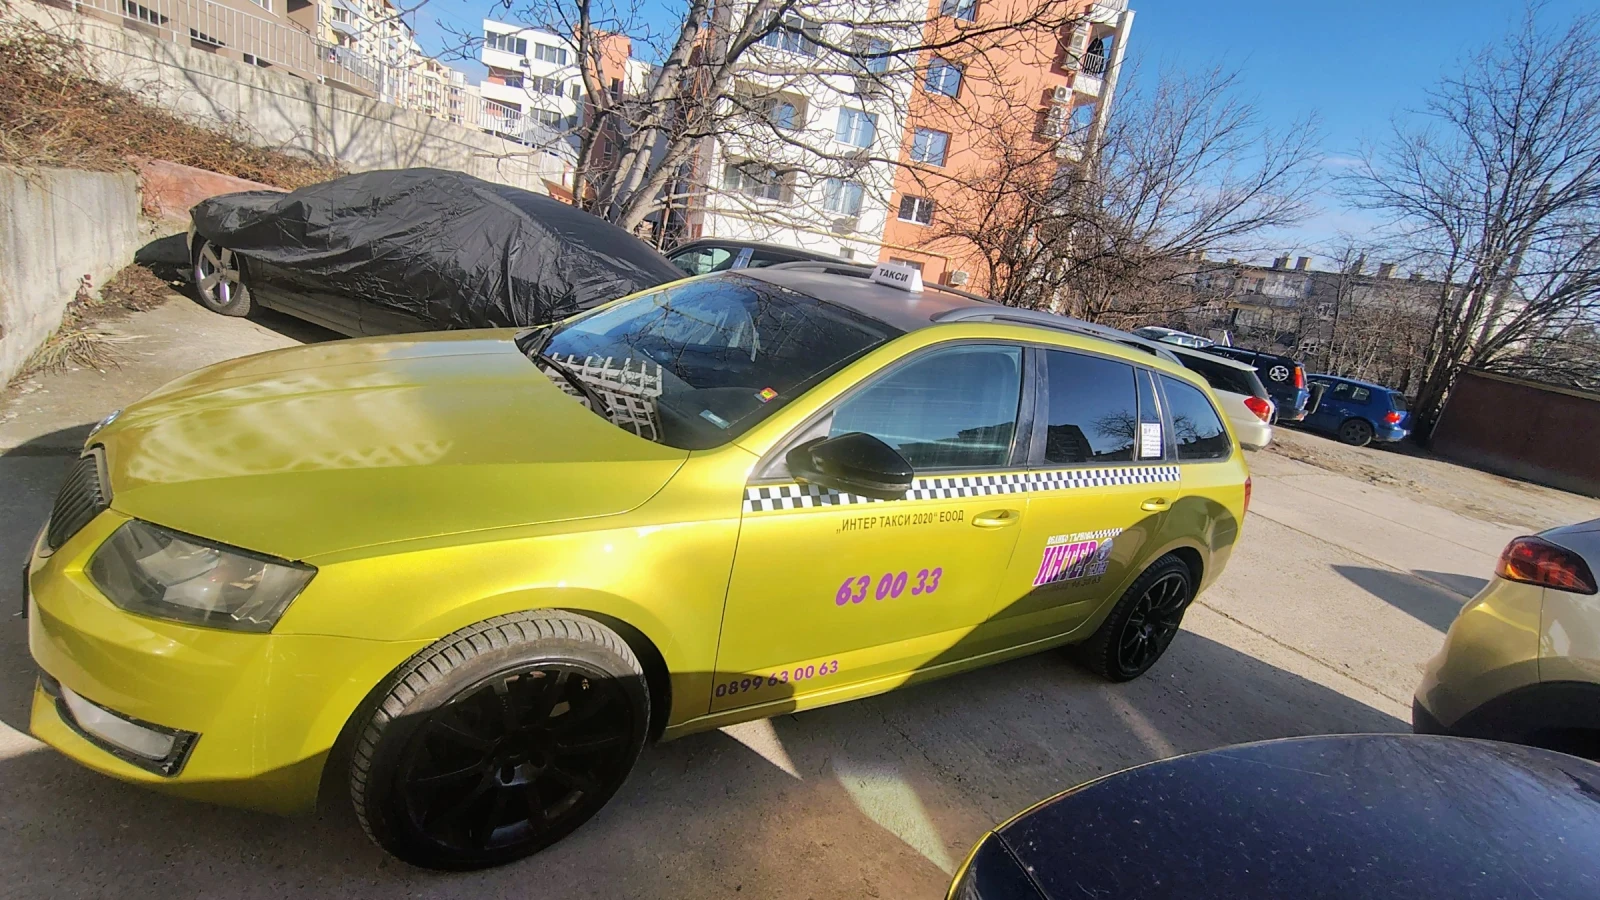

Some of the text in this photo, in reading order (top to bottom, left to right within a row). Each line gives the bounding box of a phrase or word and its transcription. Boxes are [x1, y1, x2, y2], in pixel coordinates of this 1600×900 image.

[879, 268, 909, 282] ТАКСИ
[880, 514, 911, 528] ТАКСИ
[939, 510, 964, 523] ЕООД
[1032, 540, 1098, 586] ИНТЕР
[835, 567, 943, 607] 63 00 33
[715, 660, 838, 697] 0899 63 00 63
